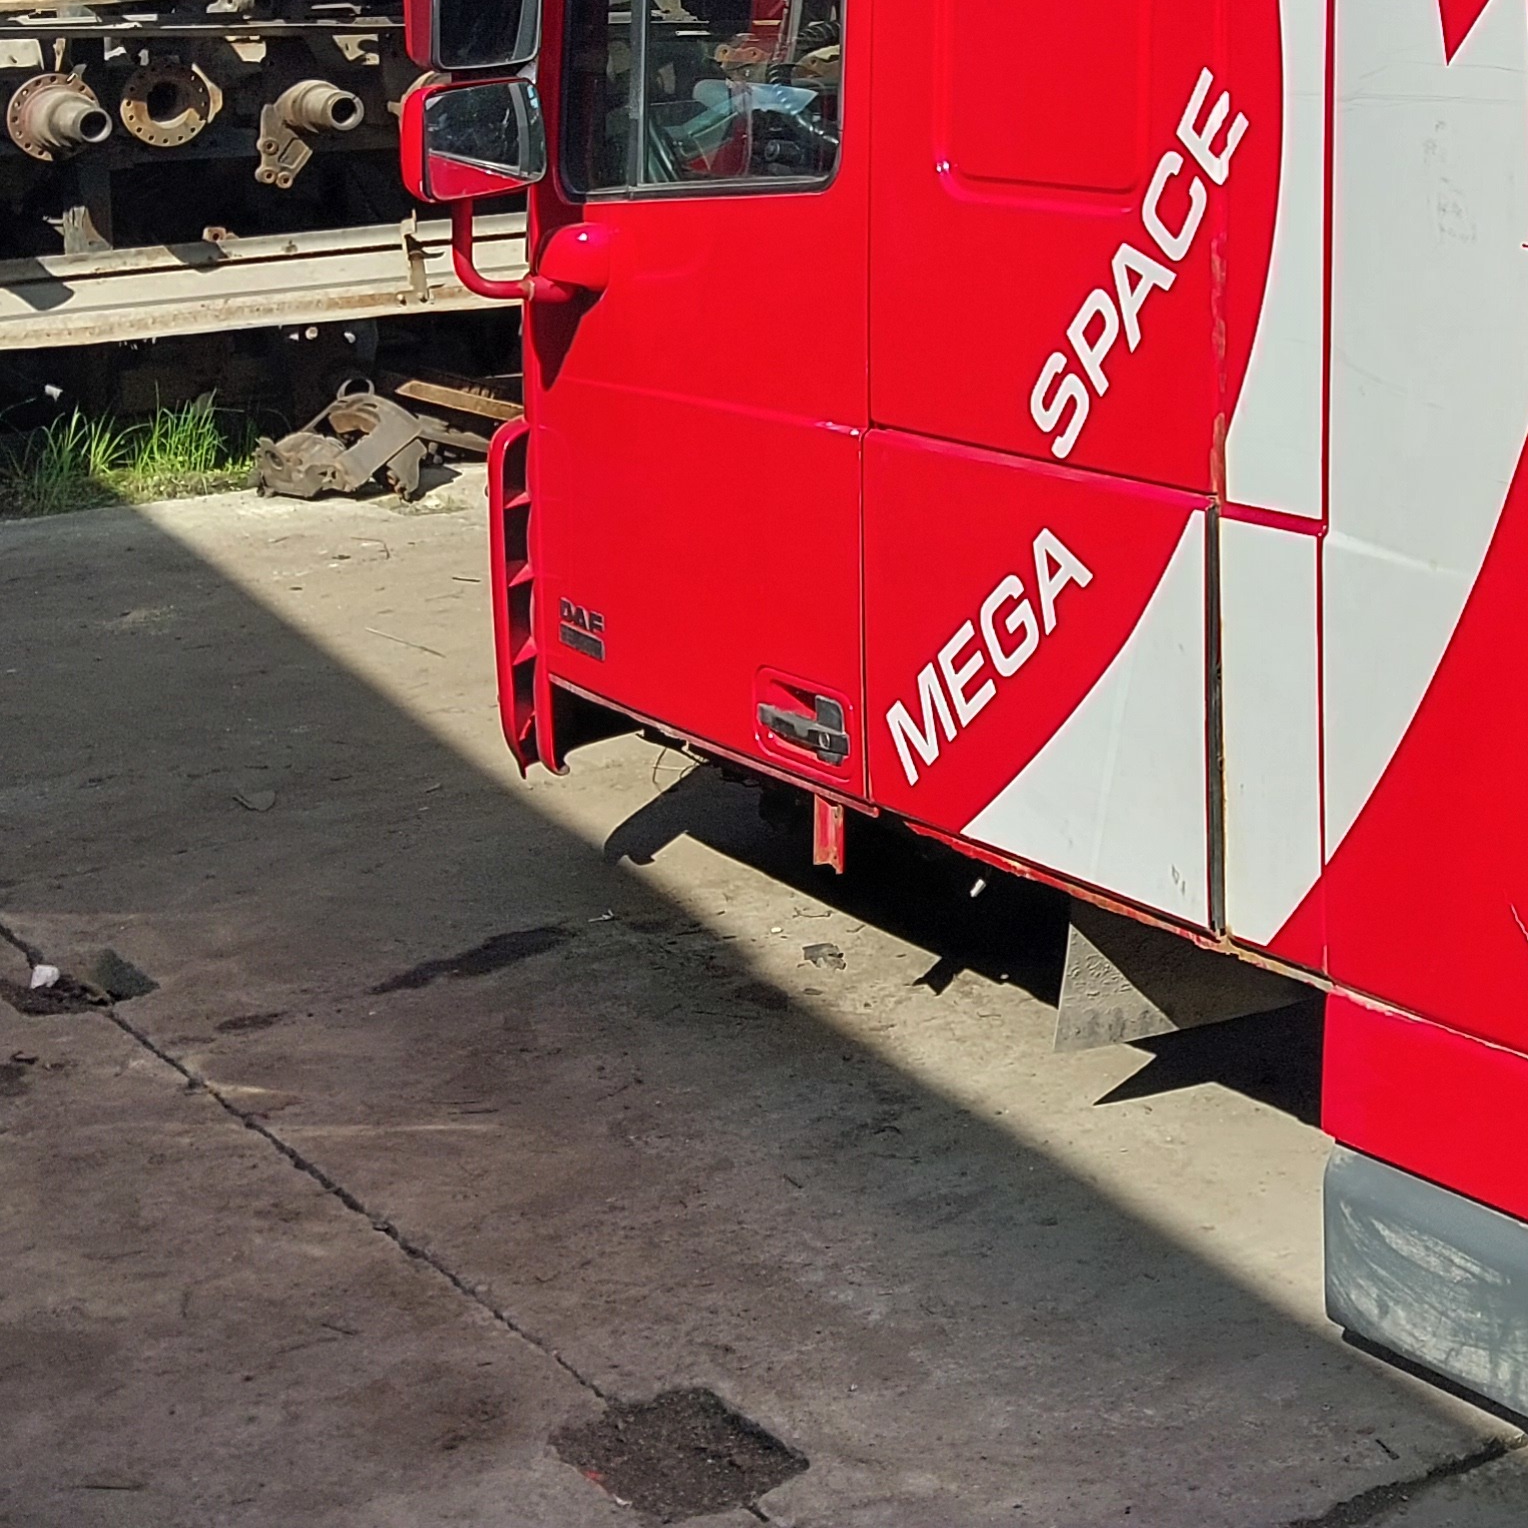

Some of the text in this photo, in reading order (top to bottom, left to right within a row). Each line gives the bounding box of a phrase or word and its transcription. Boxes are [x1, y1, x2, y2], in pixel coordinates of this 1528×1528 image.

[559, 596, 605, 633] DAF
[884, 66, 1249, 787] MEGA SPACE
